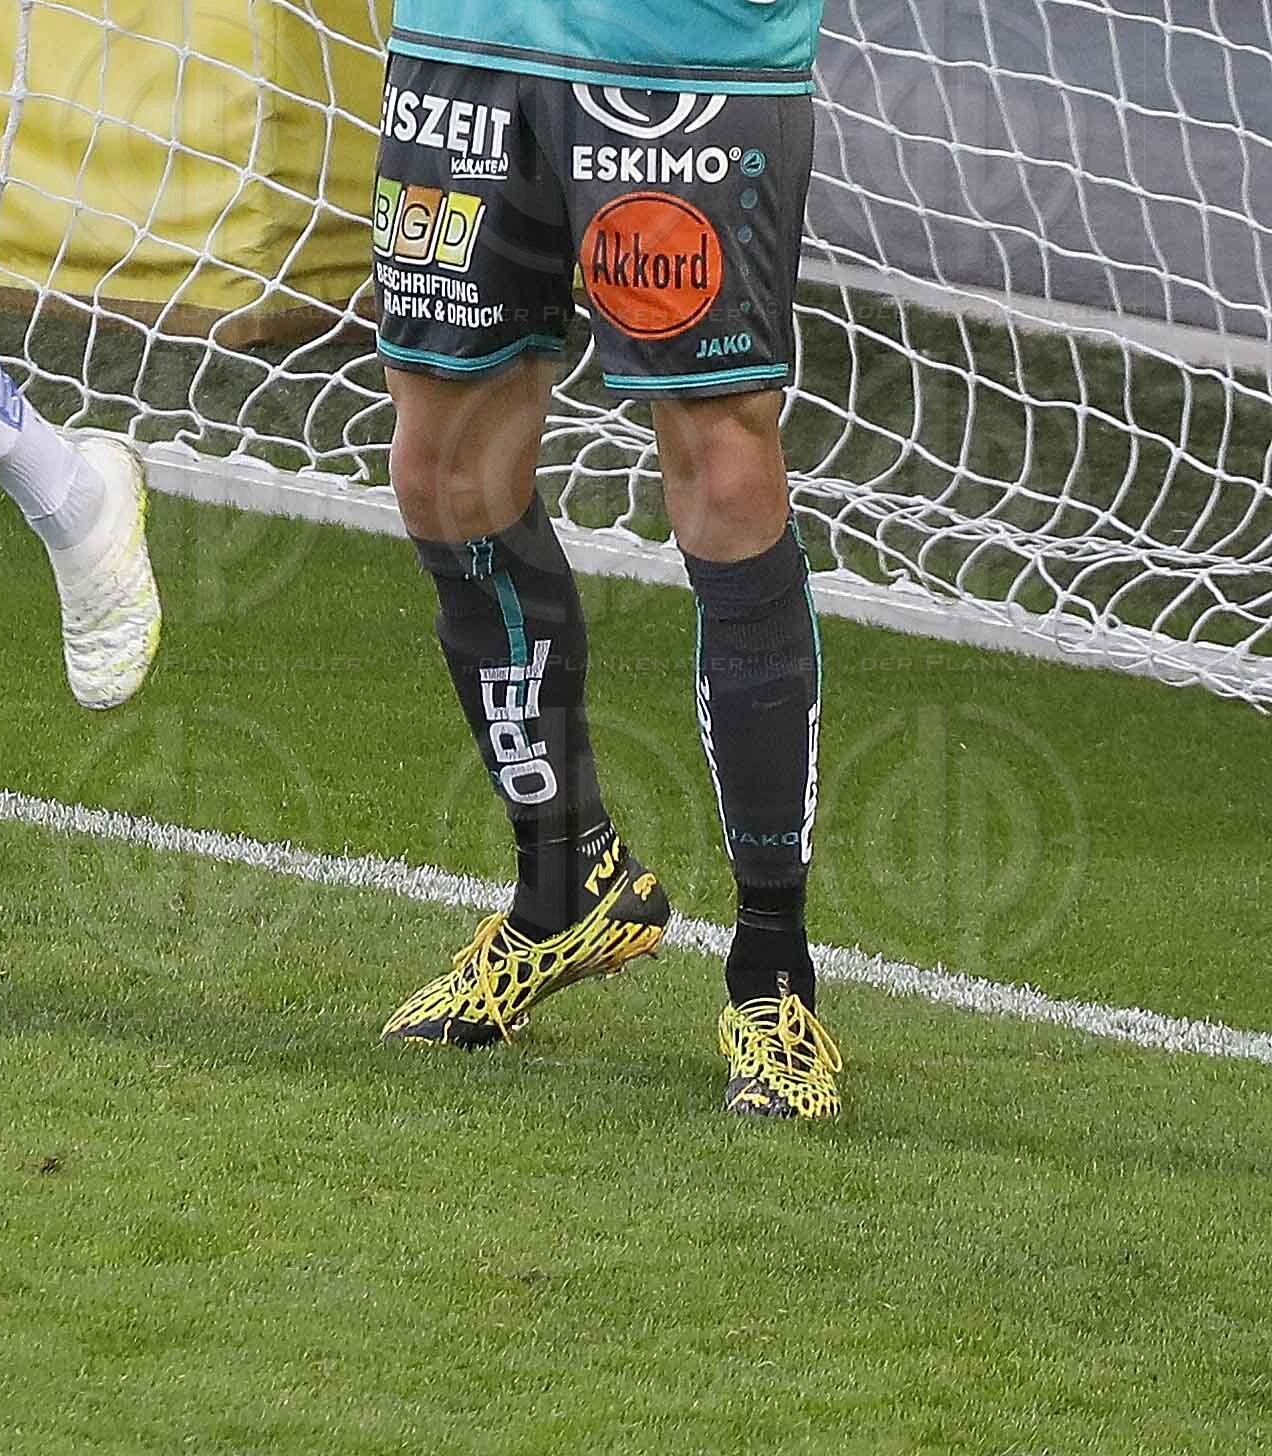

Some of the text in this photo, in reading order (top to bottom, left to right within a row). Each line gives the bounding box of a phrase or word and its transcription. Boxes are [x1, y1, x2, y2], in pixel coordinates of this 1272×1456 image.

[572, 144, 729, 184] ESKIMO
[592, 228, 709, 291] Akkord
[376, 263, 479, 304] BESCHRIFTUNG
[447, 300, 505, 331] DRUCK
[696, 334, 753, 360] JAKO
[479, 638, 558, 805] OPEL
